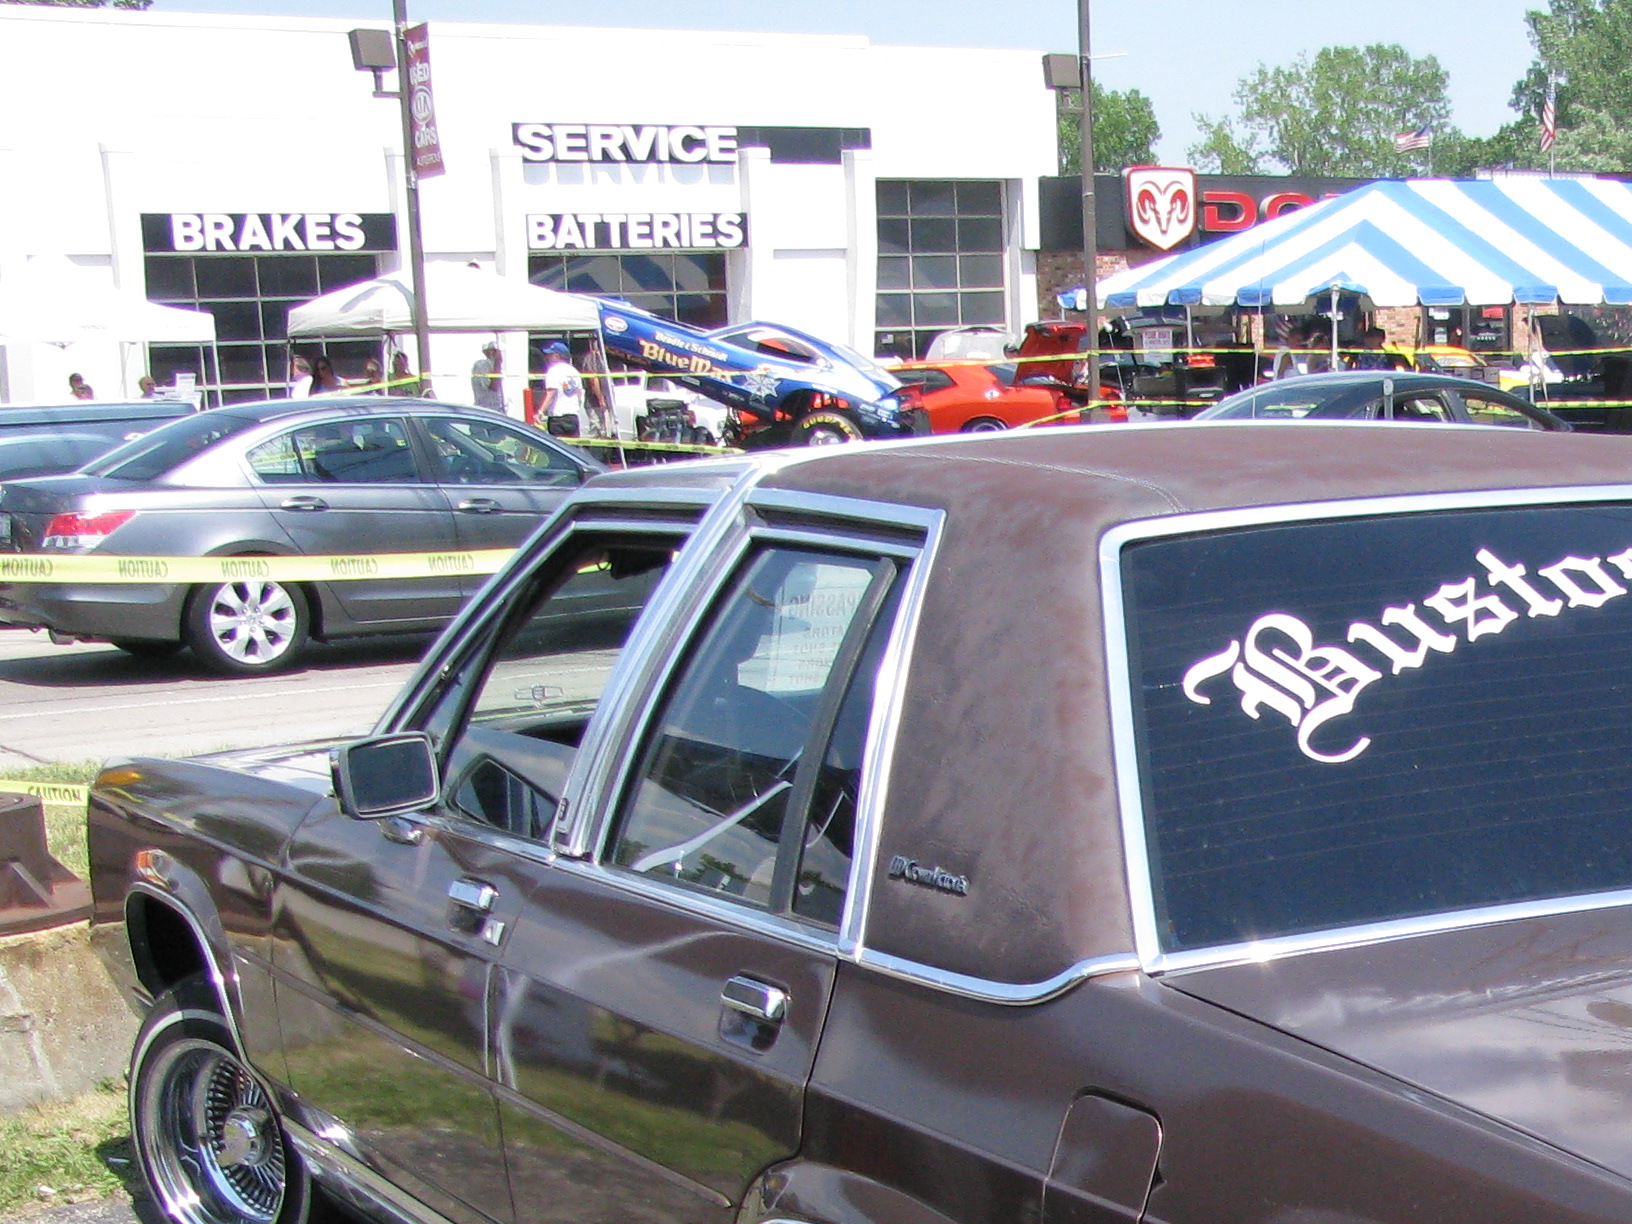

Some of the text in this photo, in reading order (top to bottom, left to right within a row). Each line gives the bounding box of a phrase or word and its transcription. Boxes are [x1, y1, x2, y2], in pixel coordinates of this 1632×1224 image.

[517, 124, 738, 162] SERVICE
[171, 213, 366, 251] BRAKES
[527, 213, 744, 249] BATTERIES
[28, 785, 83, 802] CAUTION
